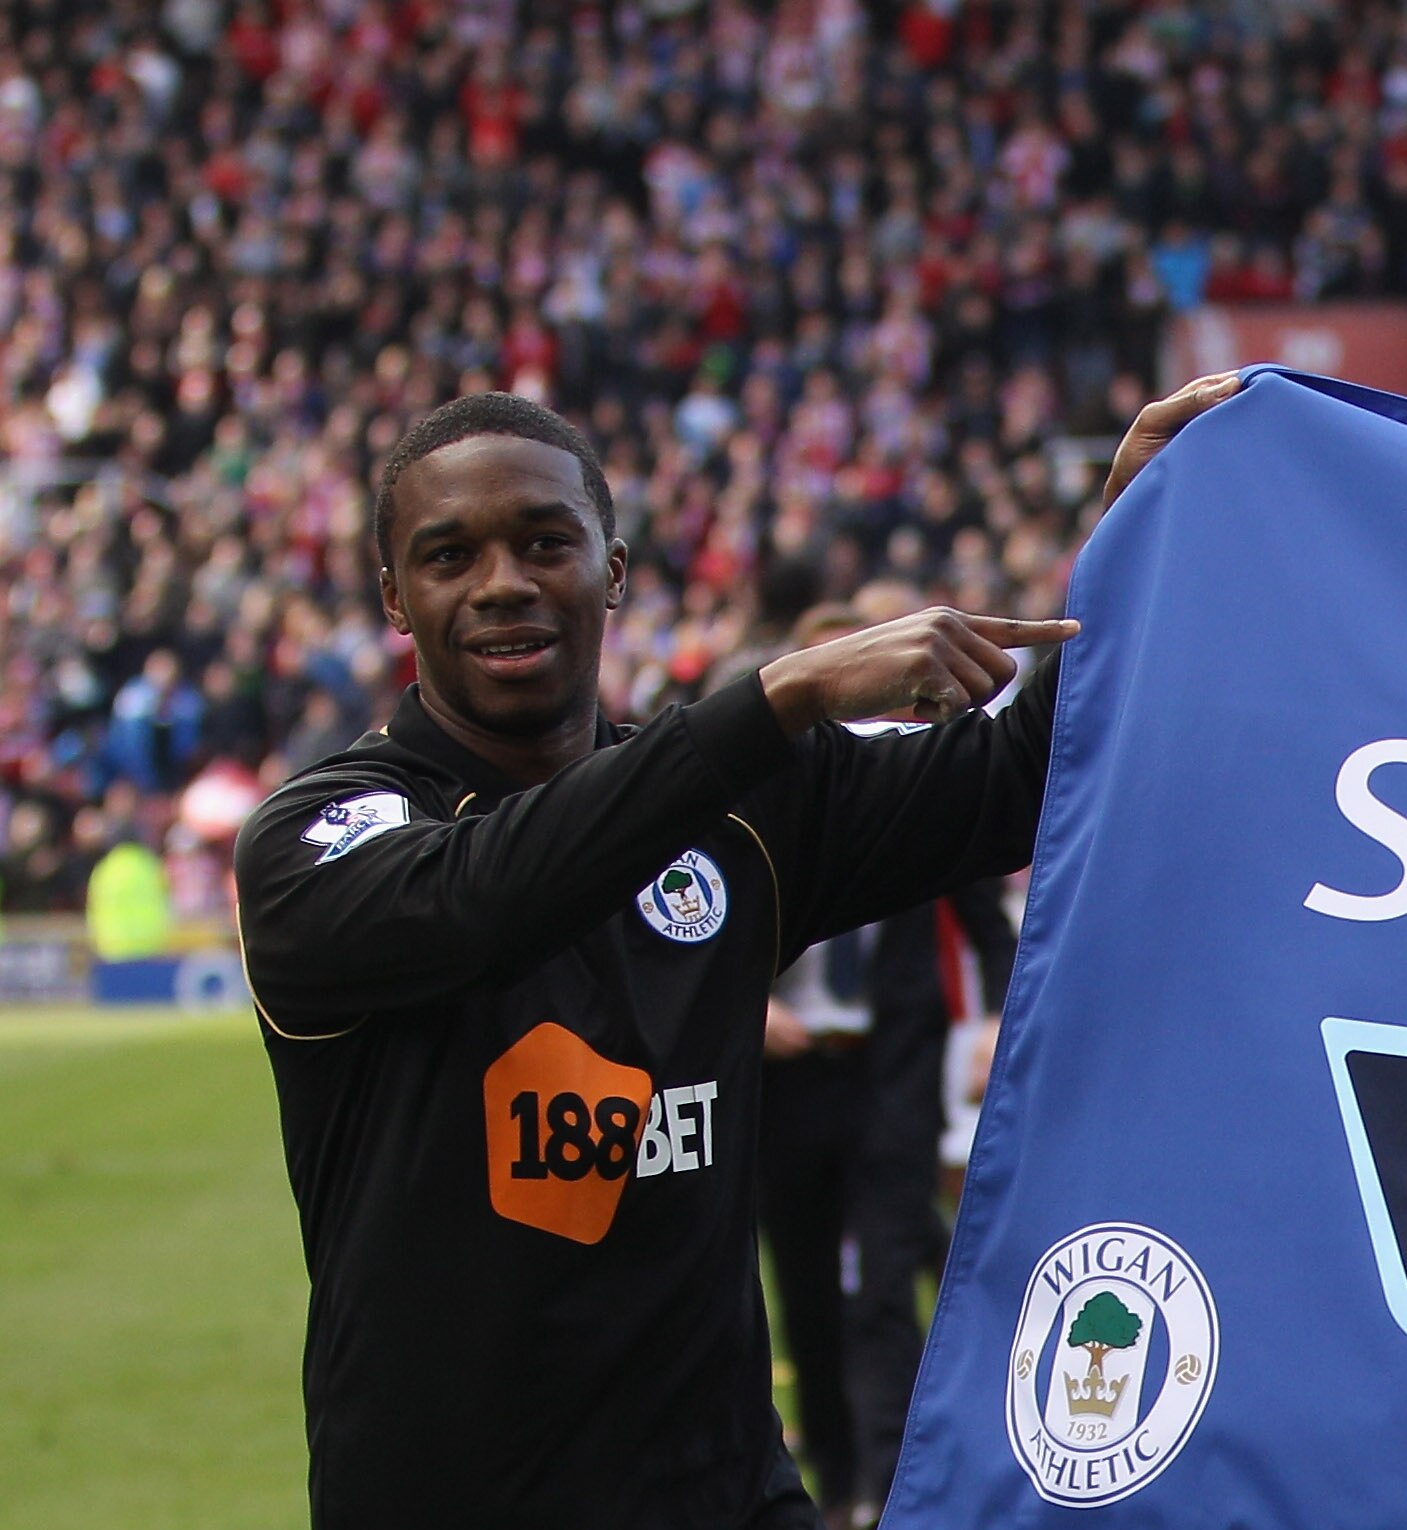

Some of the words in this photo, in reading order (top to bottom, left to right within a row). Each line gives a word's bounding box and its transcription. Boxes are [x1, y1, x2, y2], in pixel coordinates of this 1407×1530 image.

[662, 906, 723, 938] ATHLETIC
[1041, 1237, 1188, 1302] WIGAN
[1066, 1421, 1109, 1441] 1932
[1029, 1428, 1160, 1490] ATHLETIC
